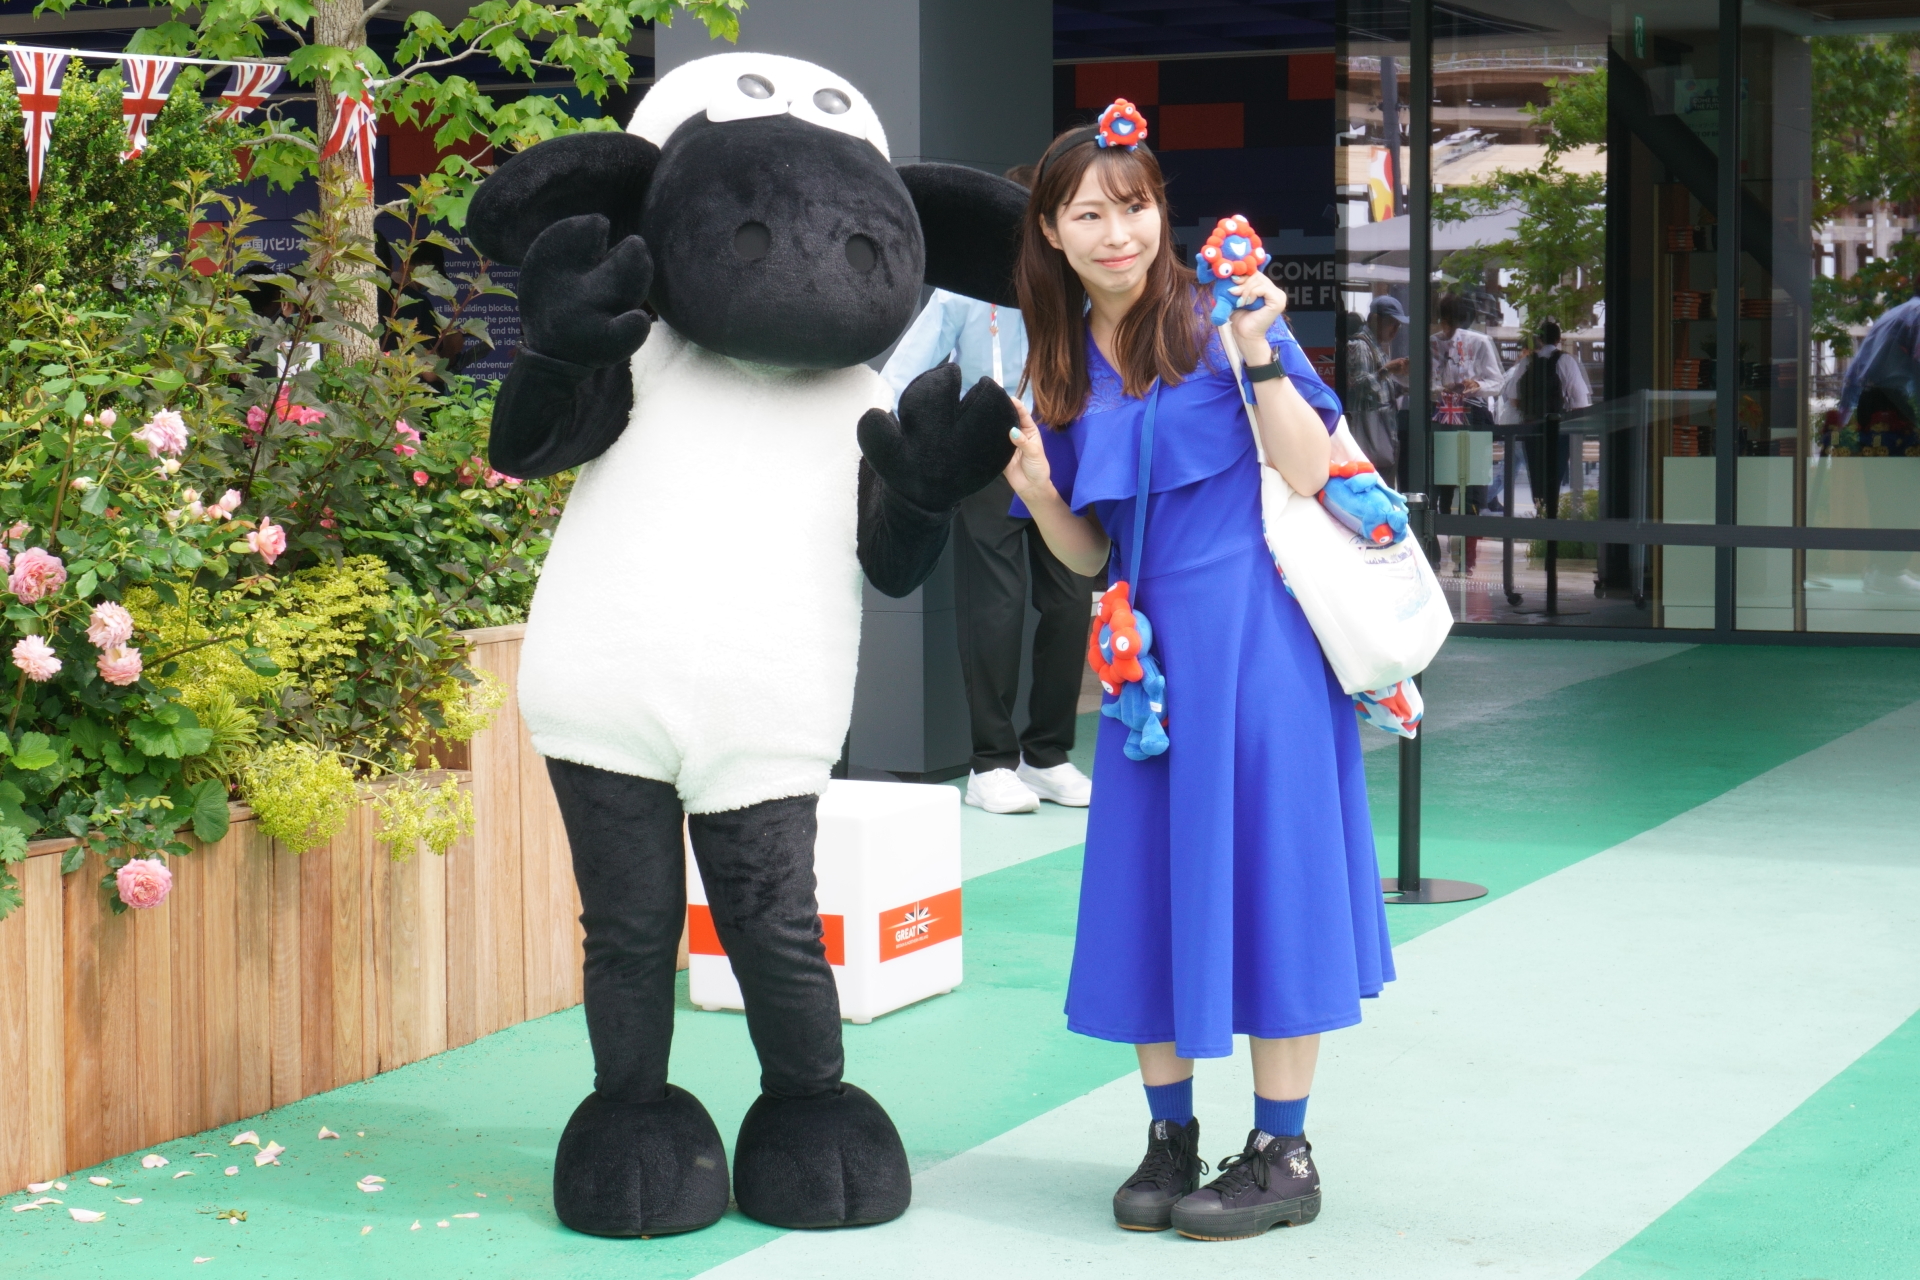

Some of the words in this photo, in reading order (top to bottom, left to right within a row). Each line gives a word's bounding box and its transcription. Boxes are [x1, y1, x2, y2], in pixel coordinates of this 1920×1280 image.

[1267, 260, 1335, 281] COME
[1280, 285, 1313, 306] HE
[488, 304, 514, 313] blocks,
[491, 326, 506, 335] and
[487, 371, 497, 380] all
[895, 925, 917, 942] GREAT
